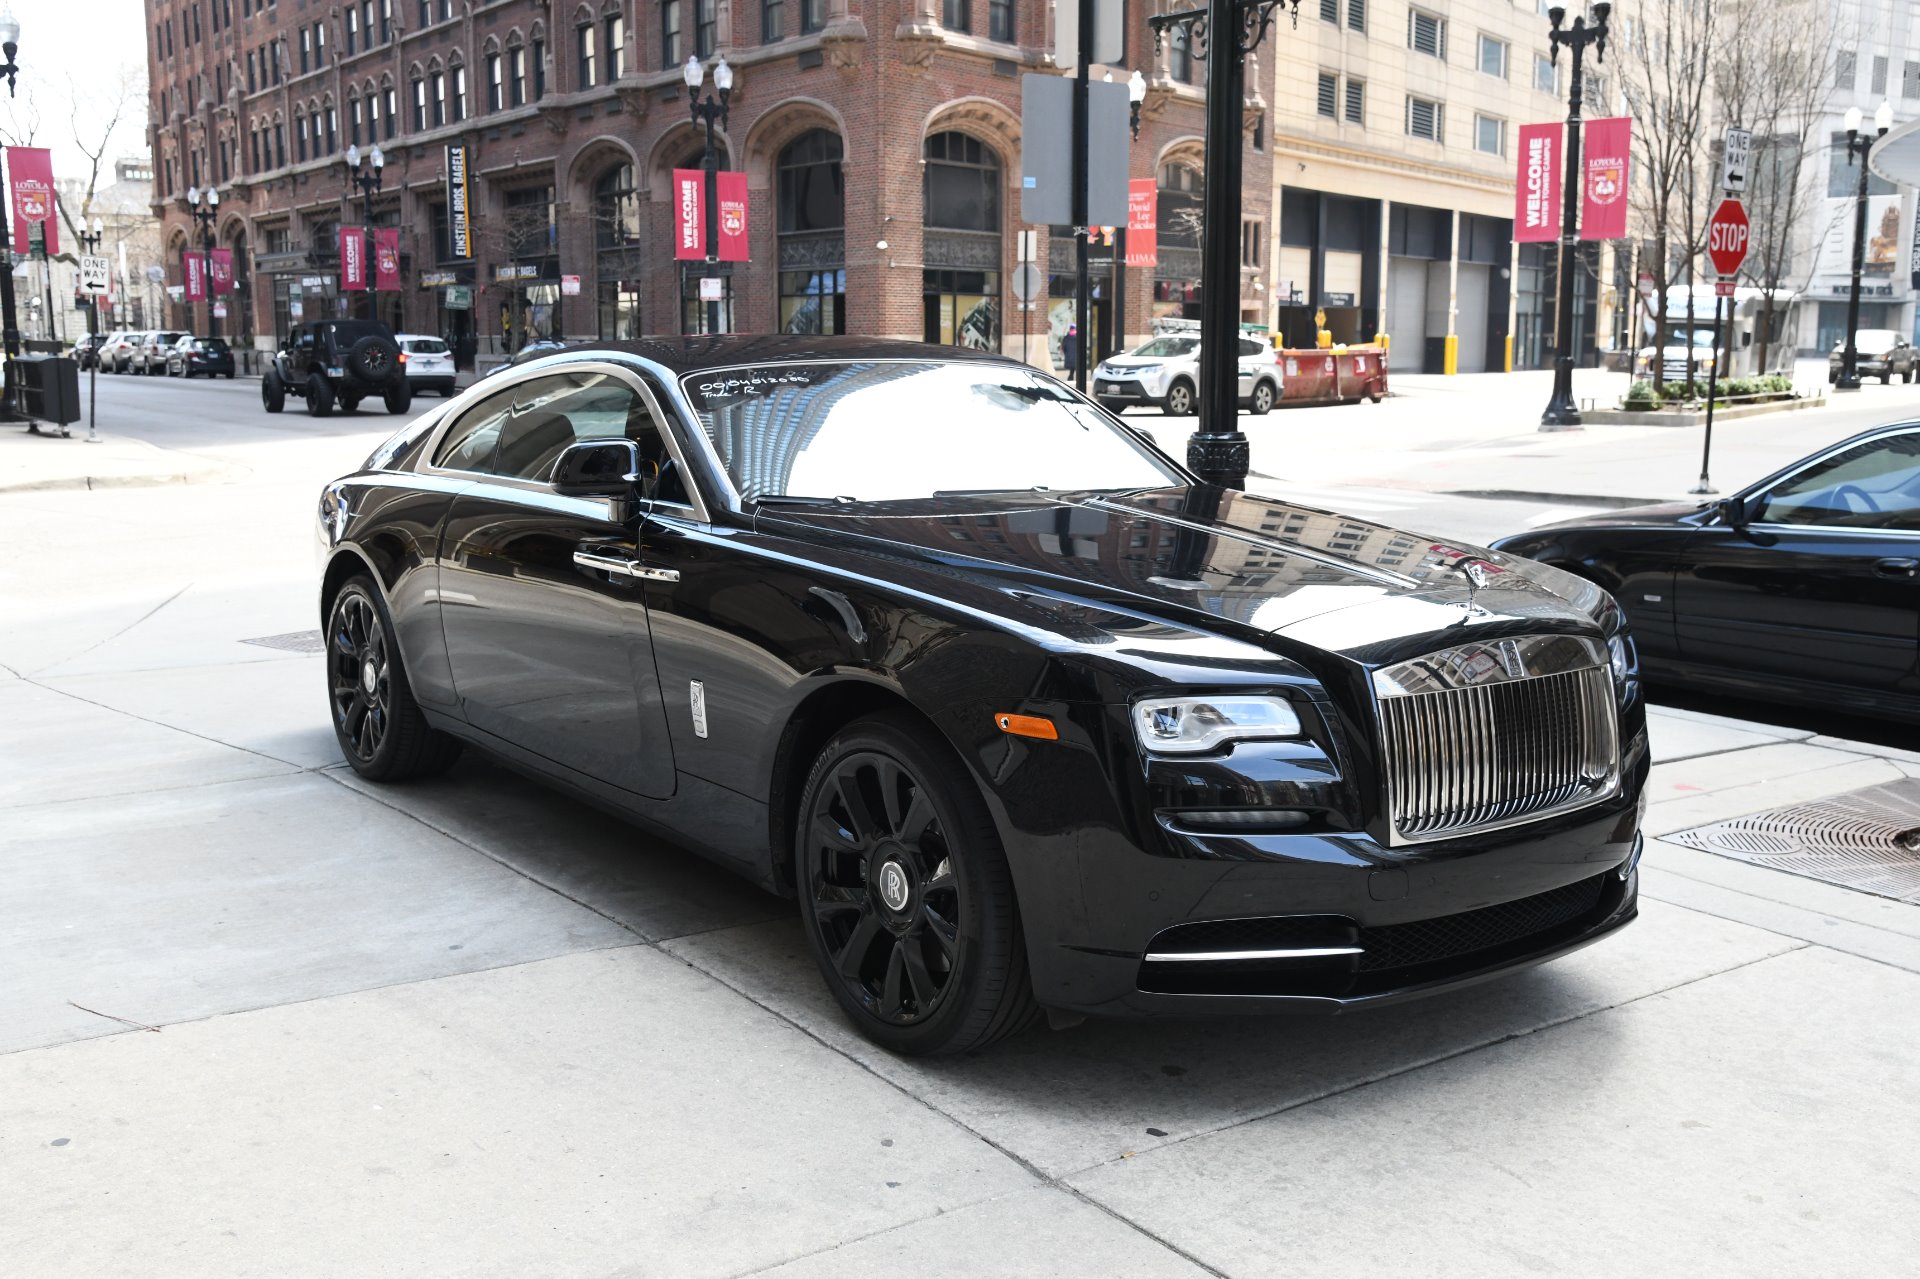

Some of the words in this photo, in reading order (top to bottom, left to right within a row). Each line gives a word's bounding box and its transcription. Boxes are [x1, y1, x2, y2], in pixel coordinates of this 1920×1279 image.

[1729, 134, 1748, 150] ONE
[451, 147, 464, 184] BAGELS
[1589, 157, 1623, 168] LOYOLA
[1727, 152, 1746, 167] WAY
[15, 181, 50, 190] LOYOLA
[1526, 137, 1543, 228] WELCOME
[454, 187, 465, 211] BROS.
[682, 180, 693, 249] WELCOME
[455, 214, 467, 255] EINSTEIN
[1711, 222, 1748, 252] STOP
[84, 259, 106, 269] ONE
[346, 235, 356, 283] WELCOME
[84, 270, 106, 279] WAY
